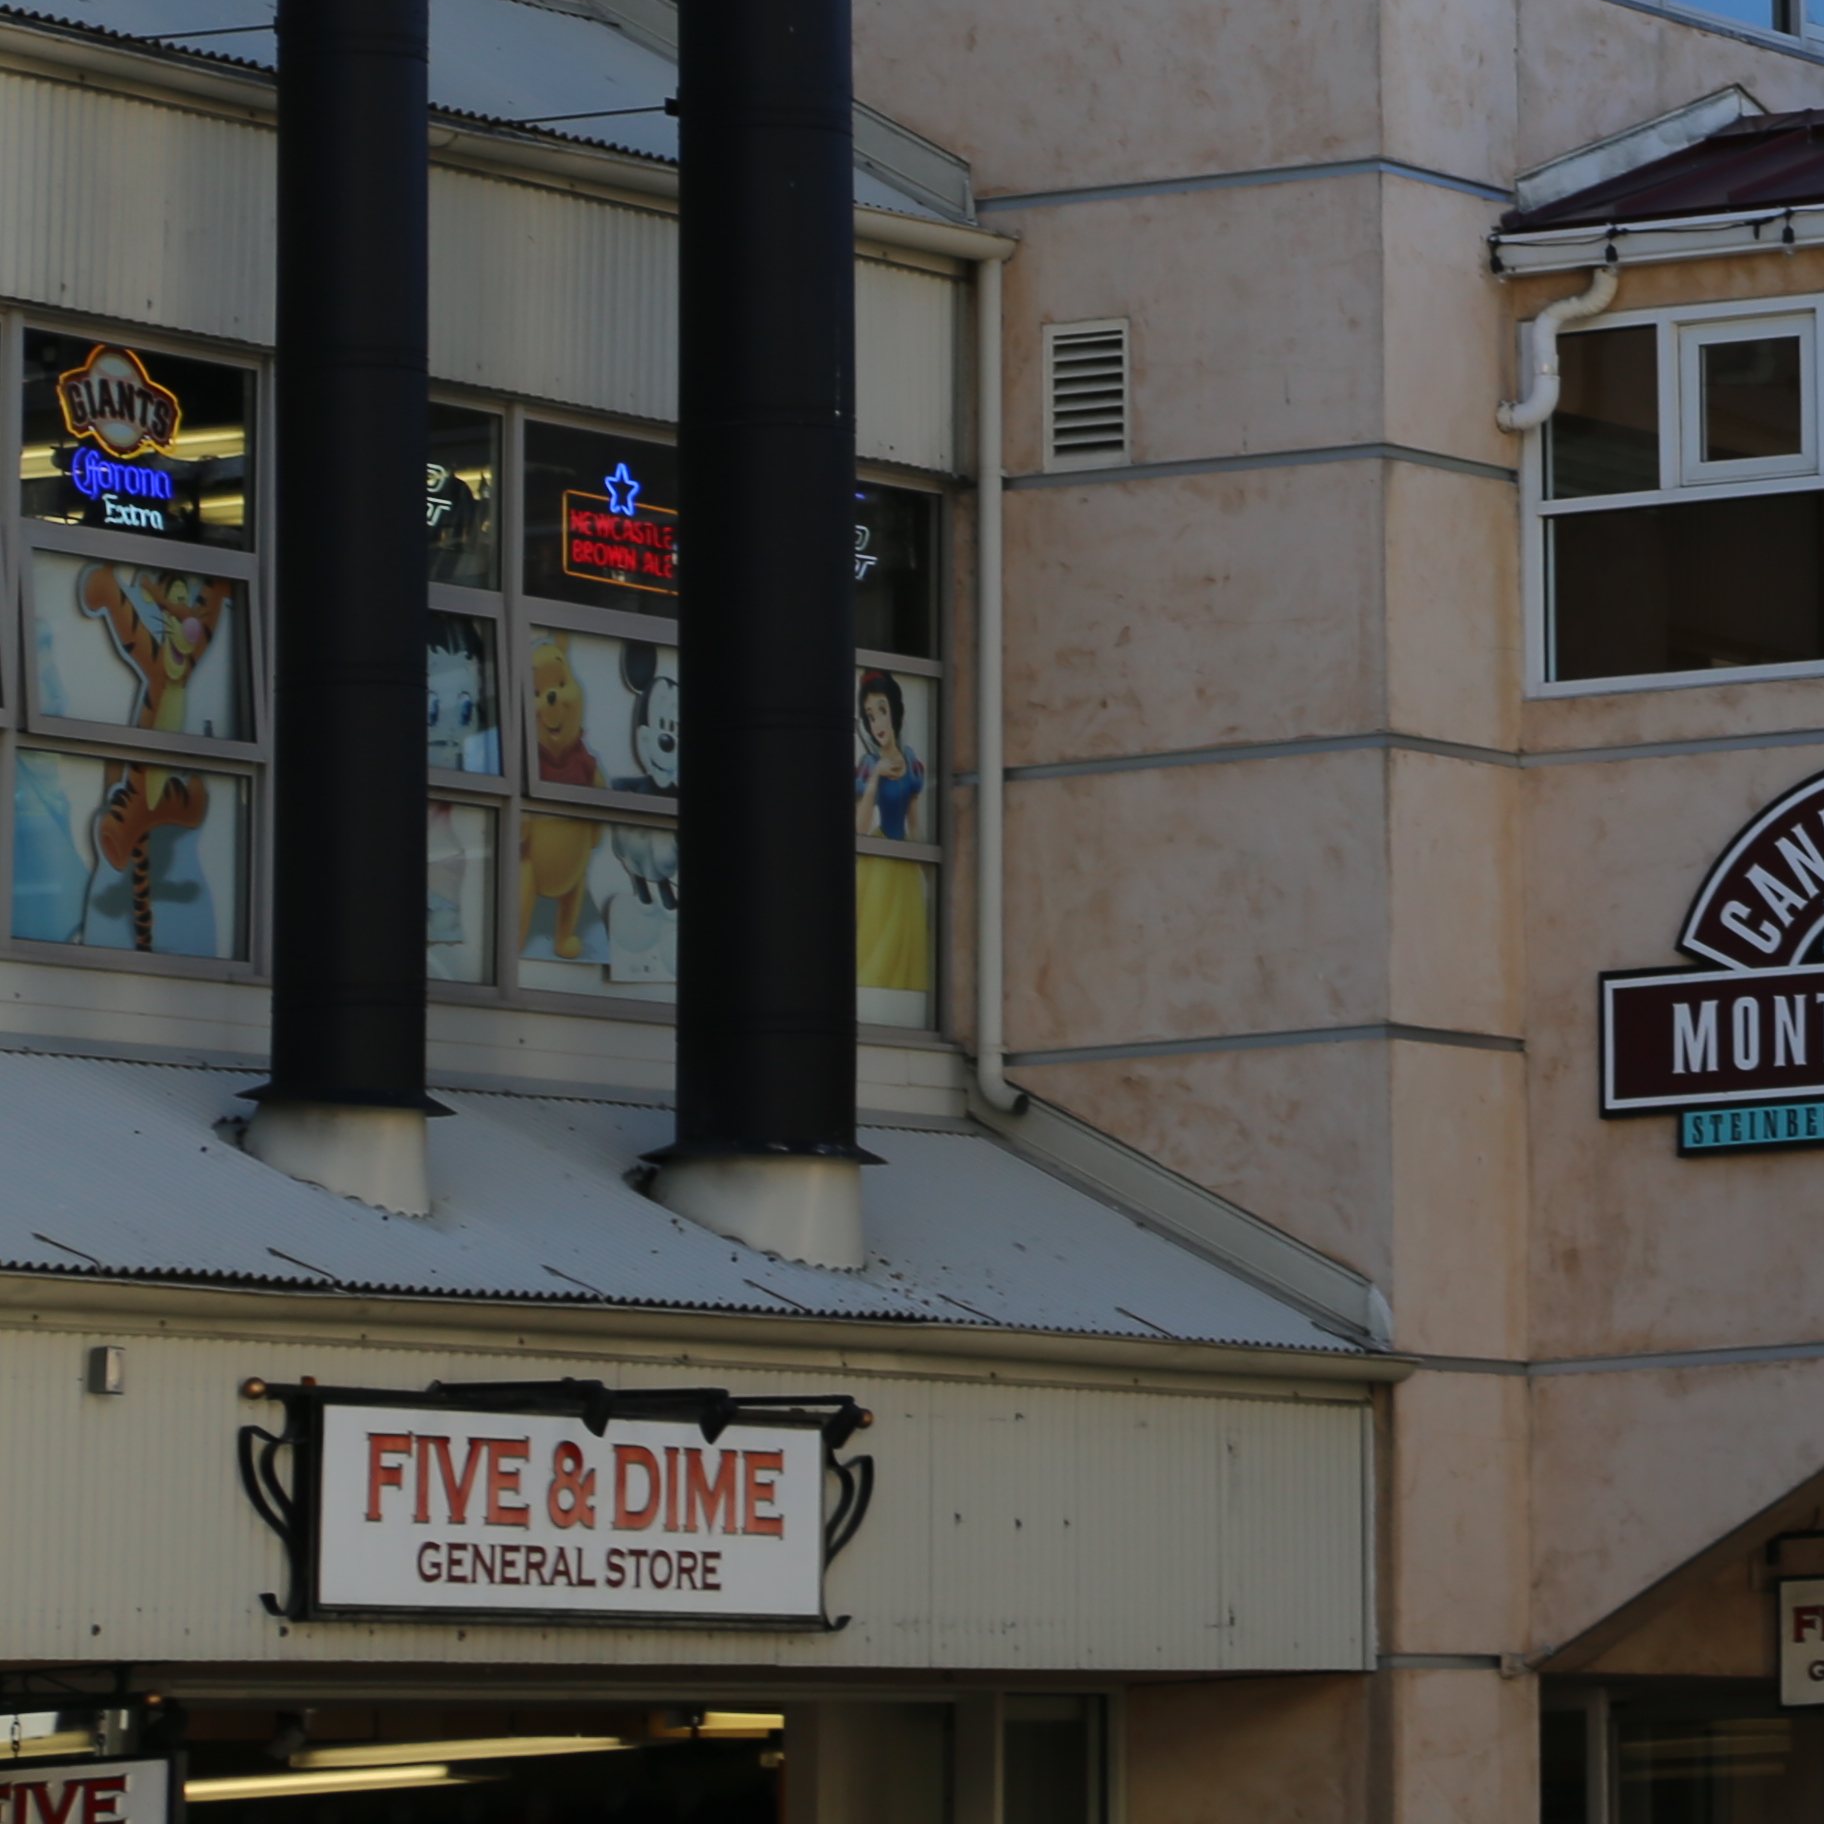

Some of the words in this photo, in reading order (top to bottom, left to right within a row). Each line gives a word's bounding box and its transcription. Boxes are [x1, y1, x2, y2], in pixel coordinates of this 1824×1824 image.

[66, 378, 170, 440] GIANTS
[73, 446, 172, 501] Corona
[102, 492, 164, 530] Extra
[570, 509, 674, 550] NEWCASTLE
[571, 539, 638, 572] BROWN
[641, 551, 674, 578] ALE
[365, 1432, 530, 1529] FIVE
[546, 1440, 596, 1529] &
[611, 1442, 784, 1540] DIME
[416, 1541, 596, 1589] GENERAL
[604, 1549, 722, 1591] STORE
